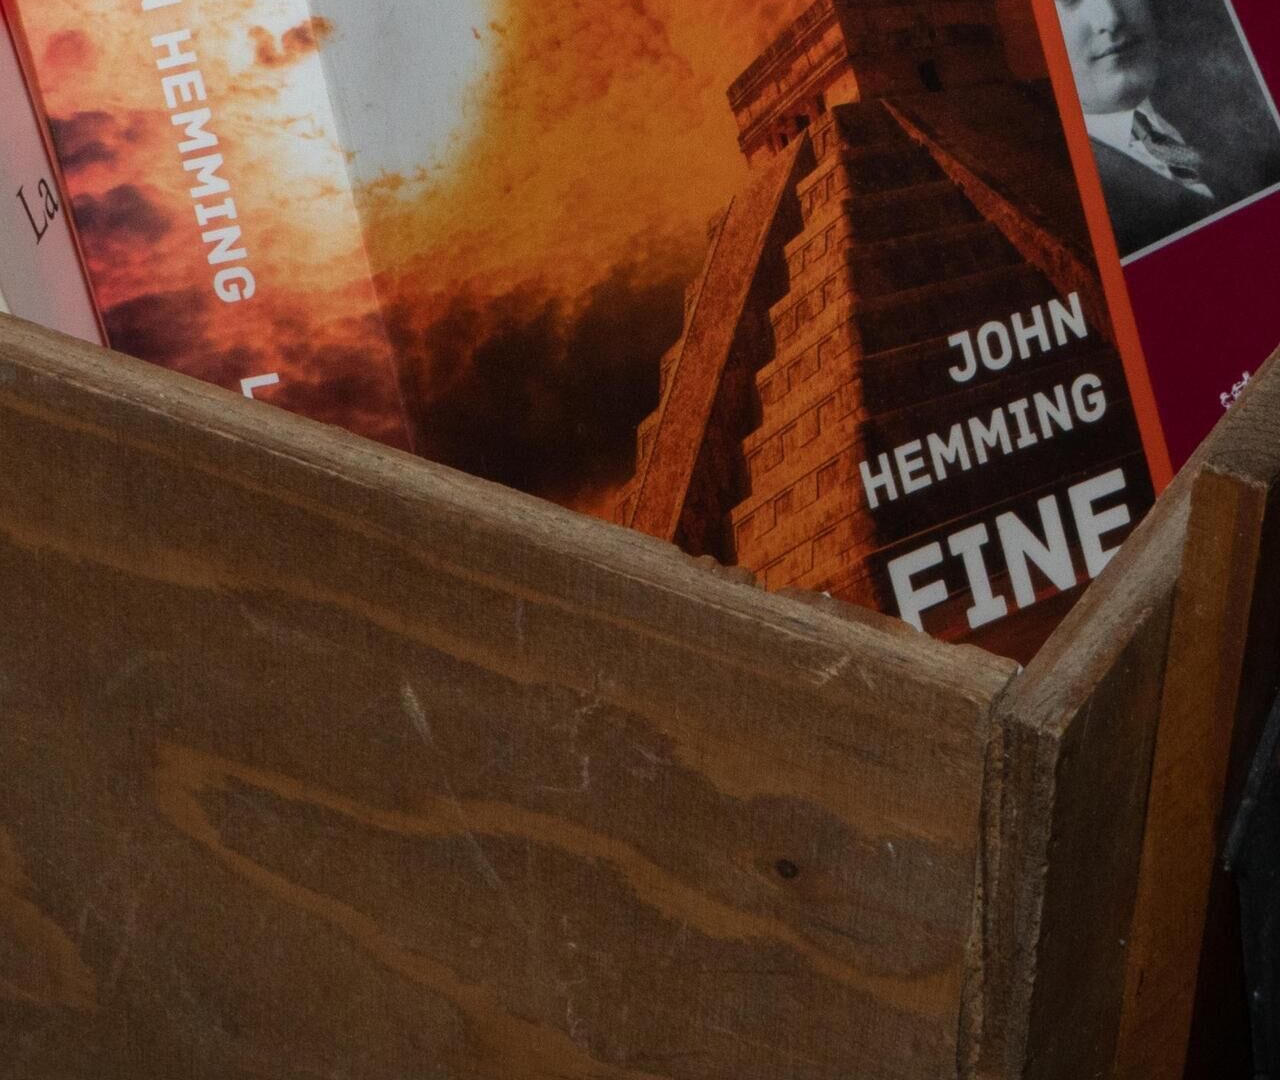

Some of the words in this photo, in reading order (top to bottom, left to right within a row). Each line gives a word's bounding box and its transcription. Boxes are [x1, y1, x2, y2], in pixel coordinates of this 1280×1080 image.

[15, 177, 59, 246] La
[151, 28, 256, 304] HEMMING
[946, 291, 1089, 385] JOHN
[858, 373, 1108, 510] HEMMING
[887, 467, 1132, 633] FINE
